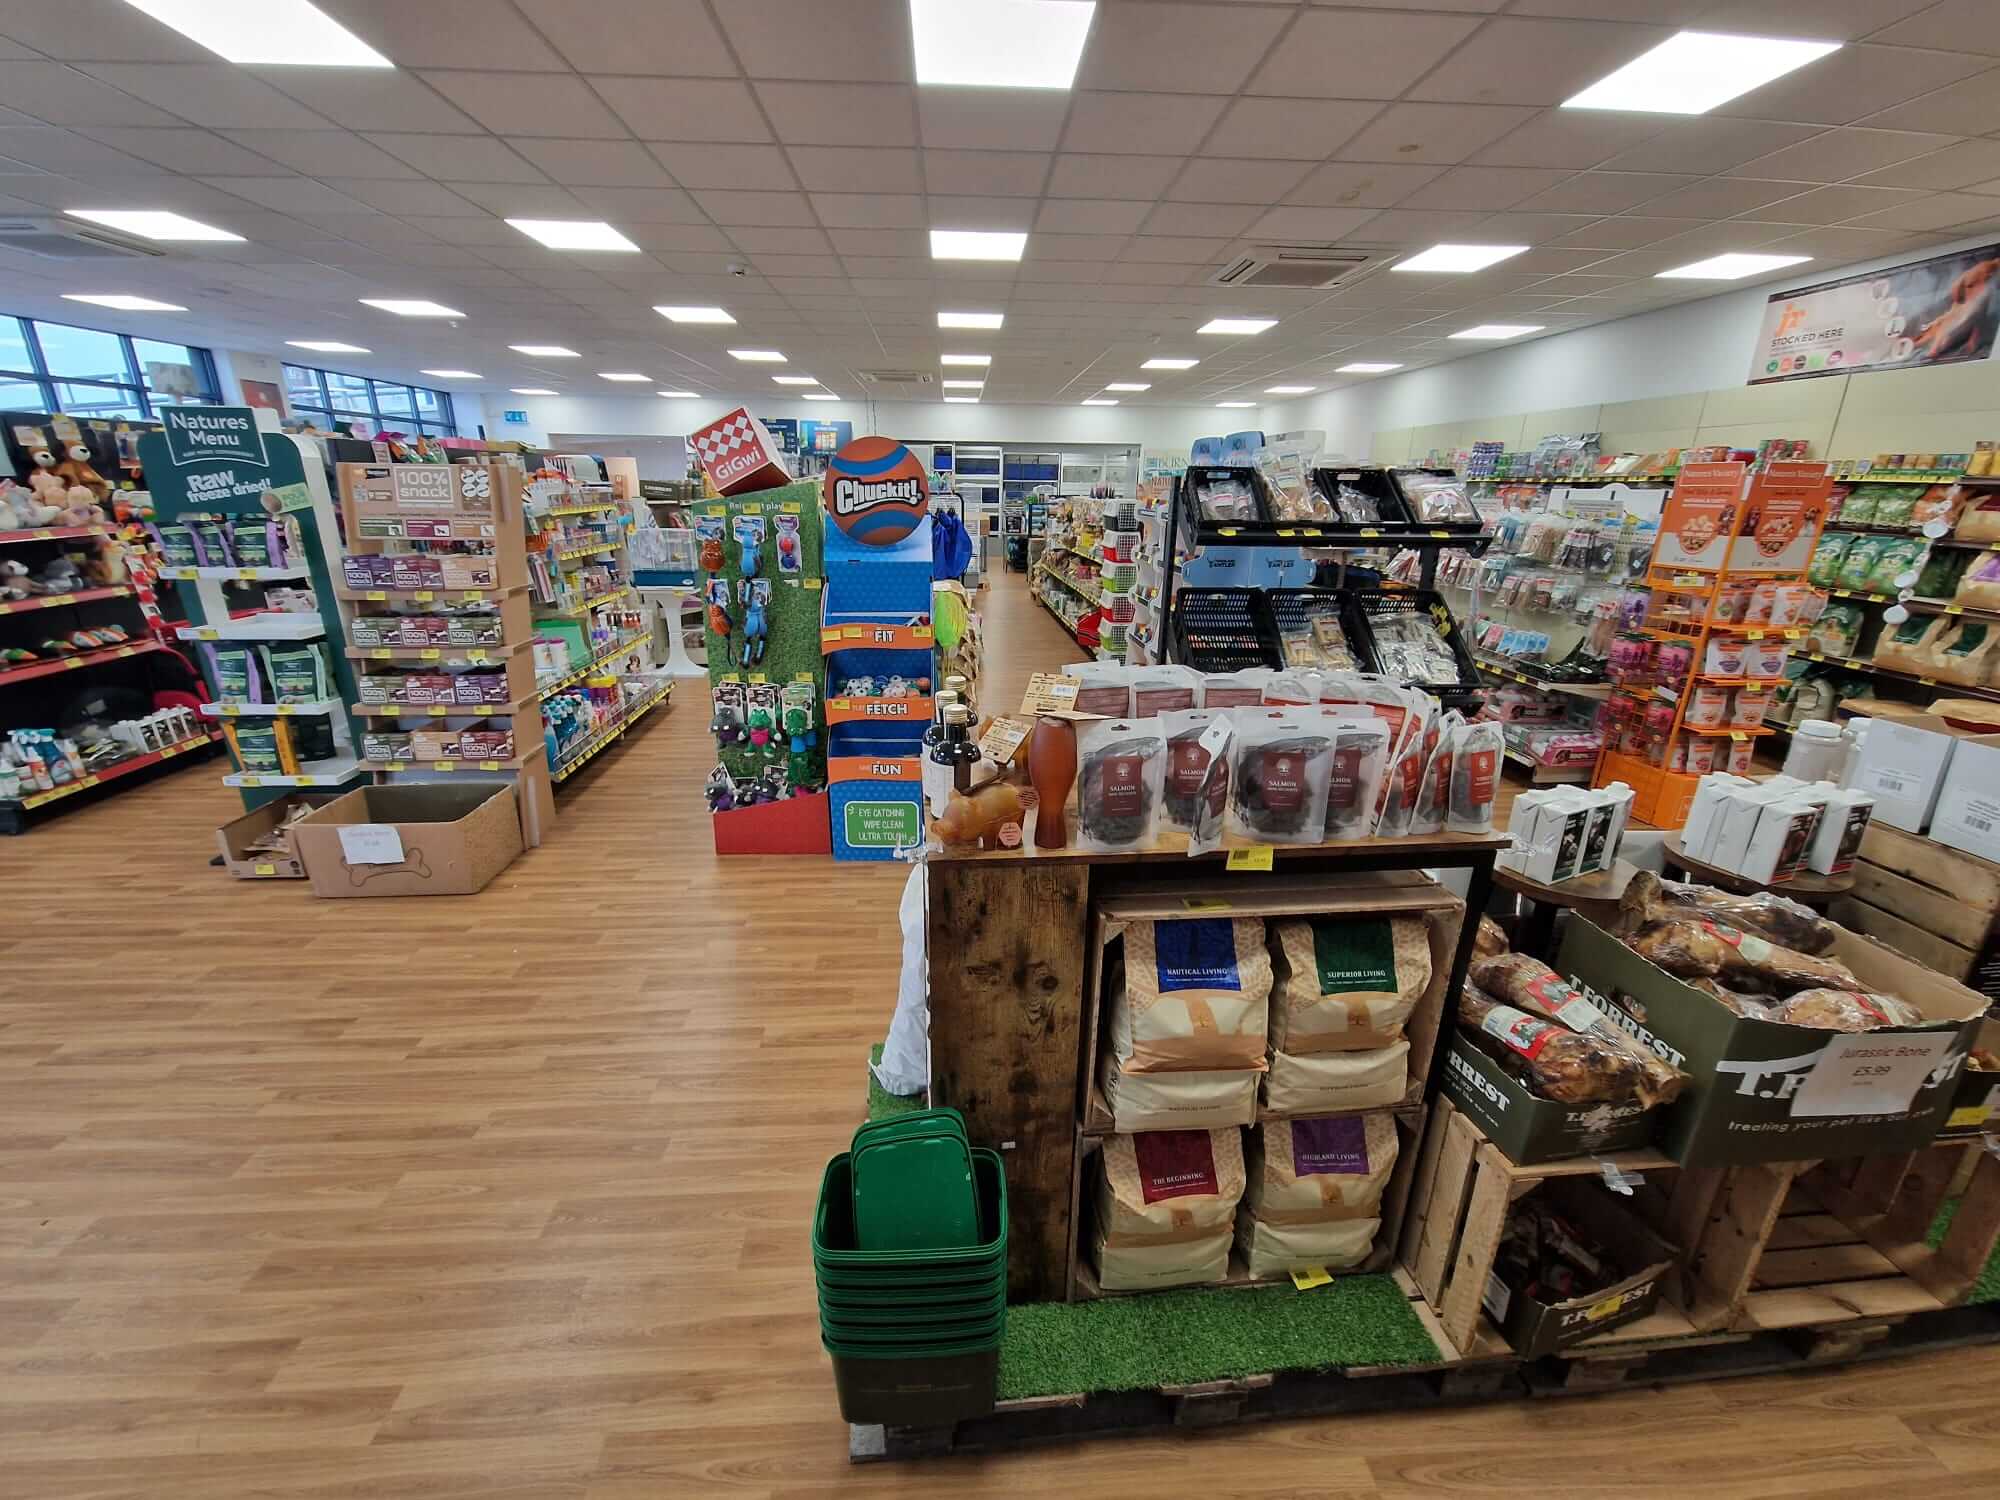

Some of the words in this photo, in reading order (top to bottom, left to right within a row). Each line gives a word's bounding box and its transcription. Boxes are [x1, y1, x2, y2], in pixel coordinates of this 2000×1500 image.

[1771, 333, 1817, 348] STOCKED
[1819, 328, 1844, 339] HERE
[169, 412, 249, 430] Natures
[188, 430, 240, 446] Menu
[715, 446, 761, 479] GiGwi
[400, 471, 449, 485] 100%
[186, 488, 231, 503] freeze
[232, 477, 272, 496] dried!
[400, 487, 449, 497] snack
[836, 479, 918, 514] Chuckit!
[874, 630, 895, 643] FIT
[866, 703, 908, 715] FETCH
[872, 763, 902, 775] FUN
[858, 808, 872, 817] EYE
[873, 808, 905, 817] CATCHING
[864, 820, 880, 829] WIPE
[882, 820, 904, 829] CLEAN
[858, 832, 881, 841] ULTRA
[1167, 968, 1201, 976] NAUTICAL
[1363, 969, 1386, 977] LIVING
[1840, 1047, 1894, 1059] Jurassic
[1896, 1045, 1931, 1056] Bone
[1853, 1065, 1891, 1076] £5.99
[1728, 1120, 1789, 1133] treating
[1793, 1120, 1824, 1132] your
[1828, 1116, 1852, 1129] pet
[1856, 1113, 1881, 1125] like
[1302, 1153, 1336, 1161] HIGHLAND
[1167, 1172, 1204, 1183] BEGINNING
